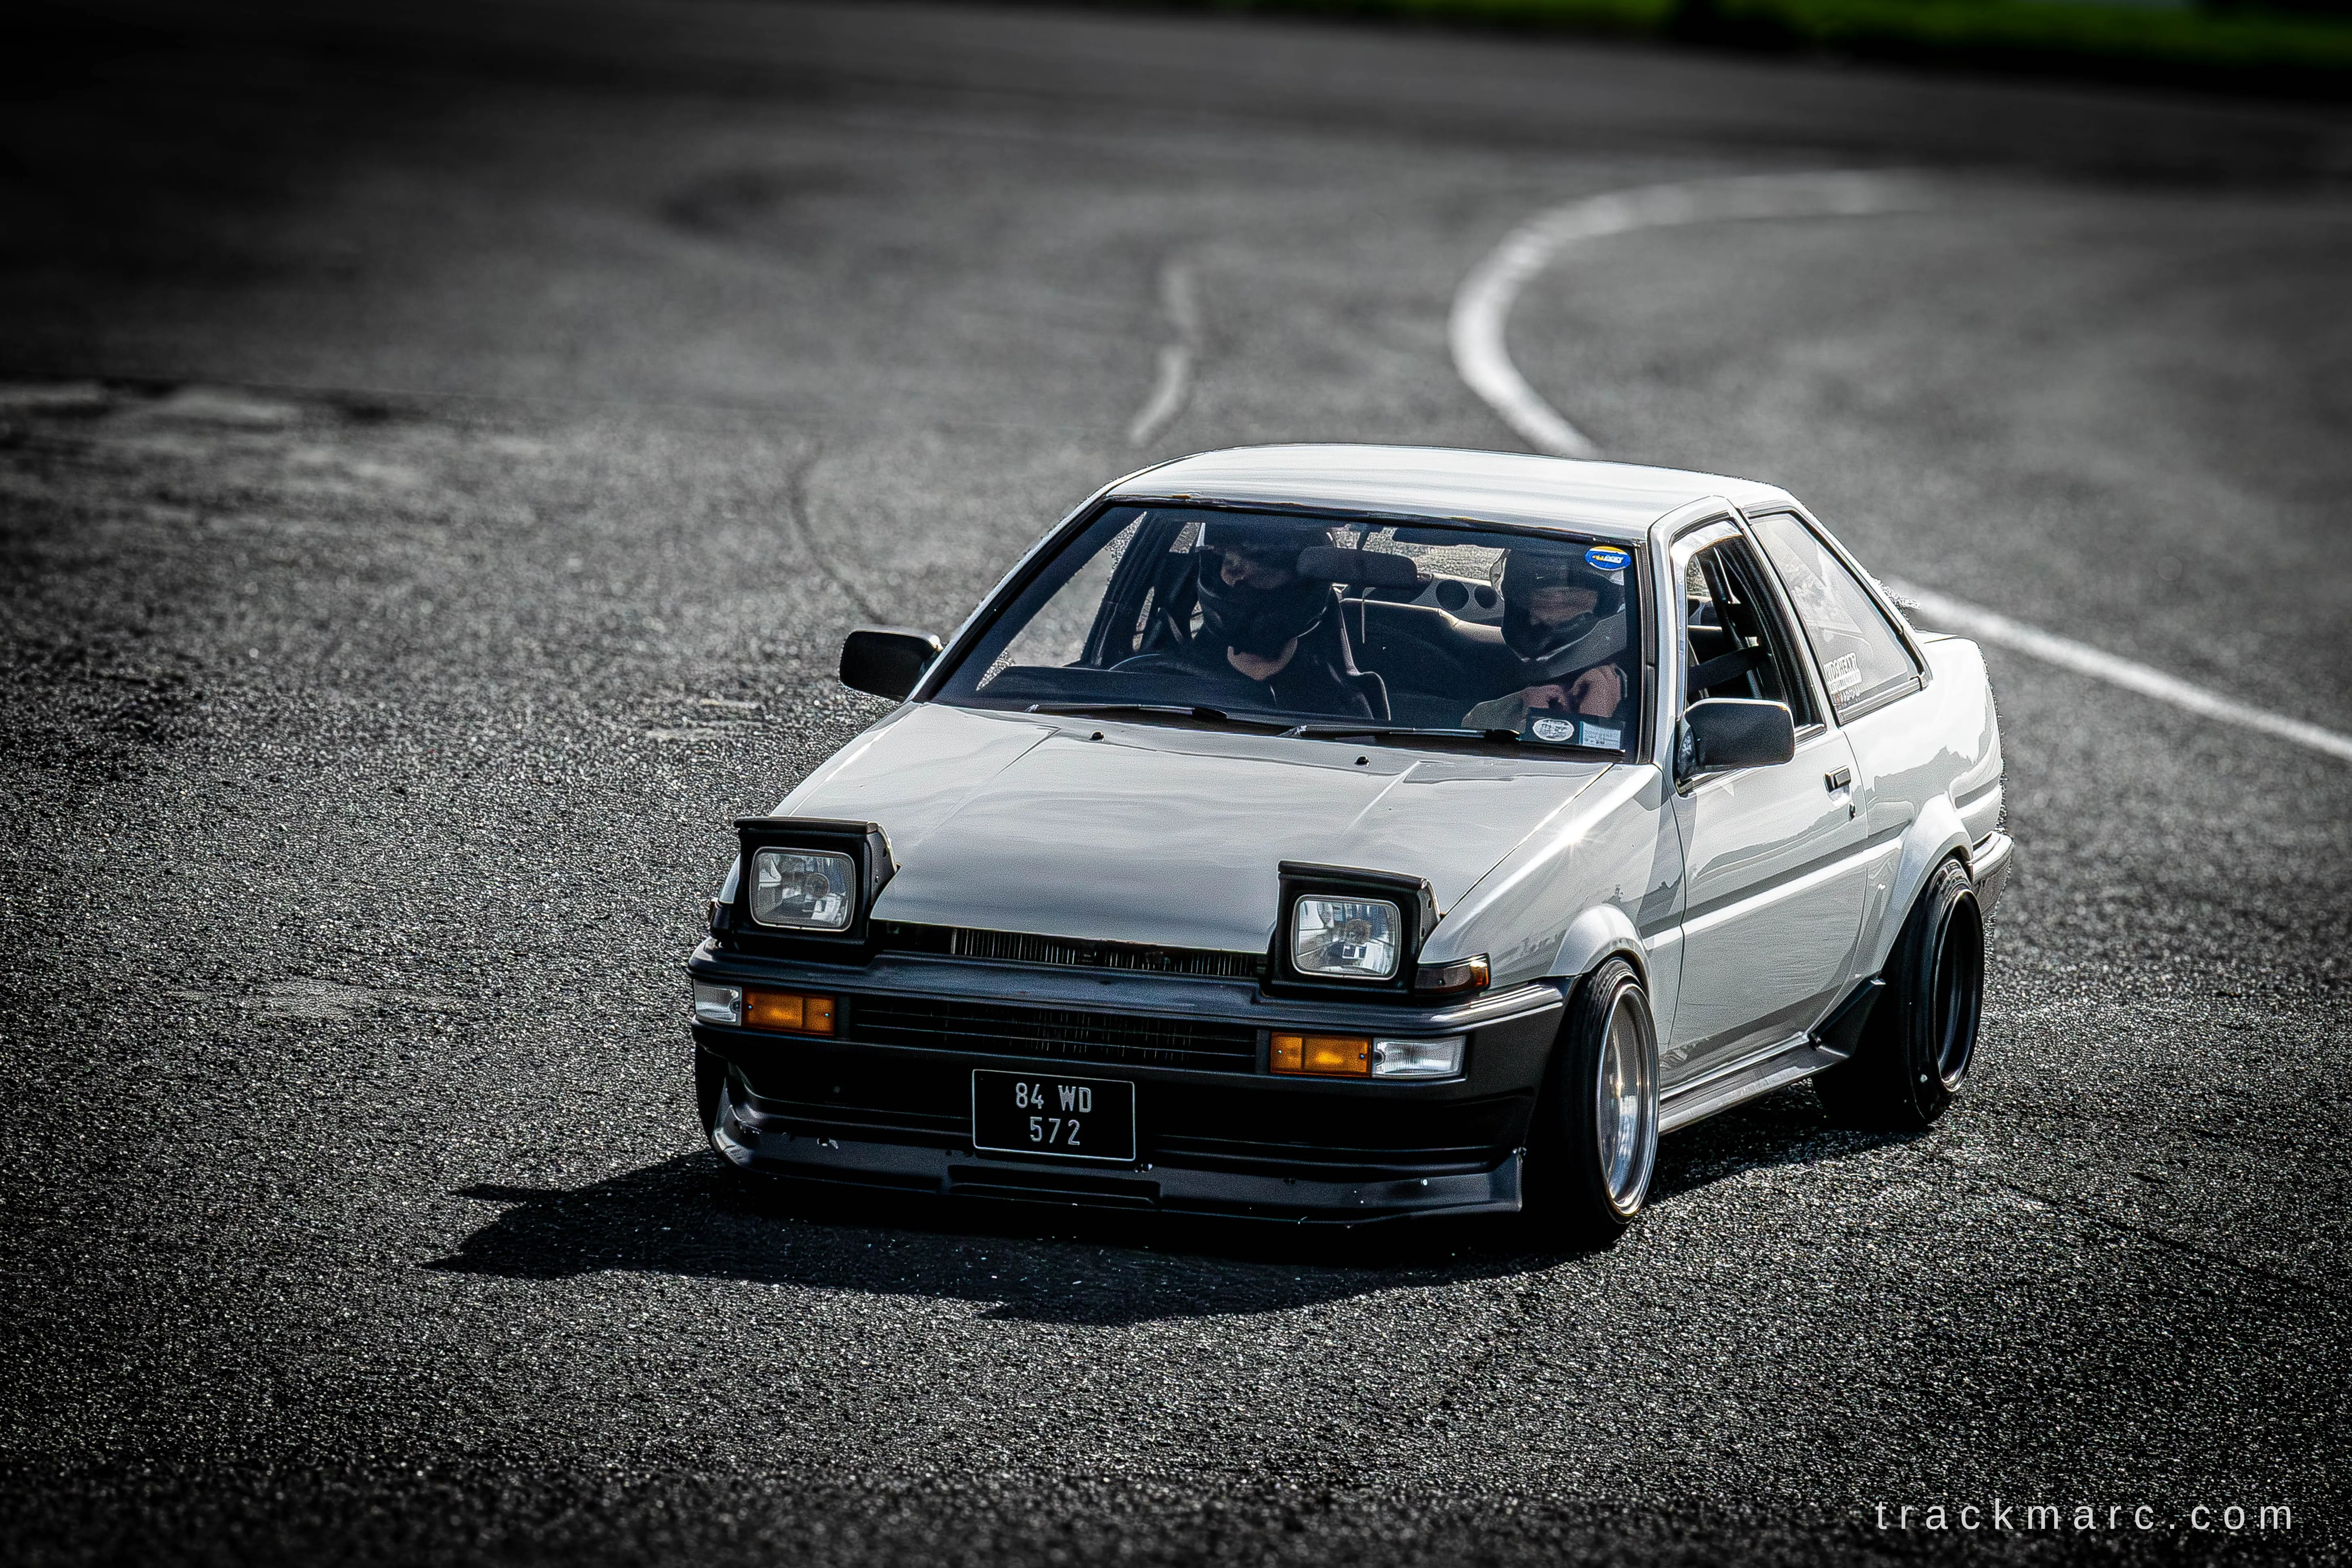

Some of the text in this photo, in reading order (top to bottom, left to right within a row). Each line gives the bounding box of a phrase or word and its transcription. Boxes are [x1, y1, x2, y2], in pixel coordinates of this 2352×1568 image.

[1015, 1082, 1091, 1113] 84 WD
[1030, 1116, 1080, 1146] 572
